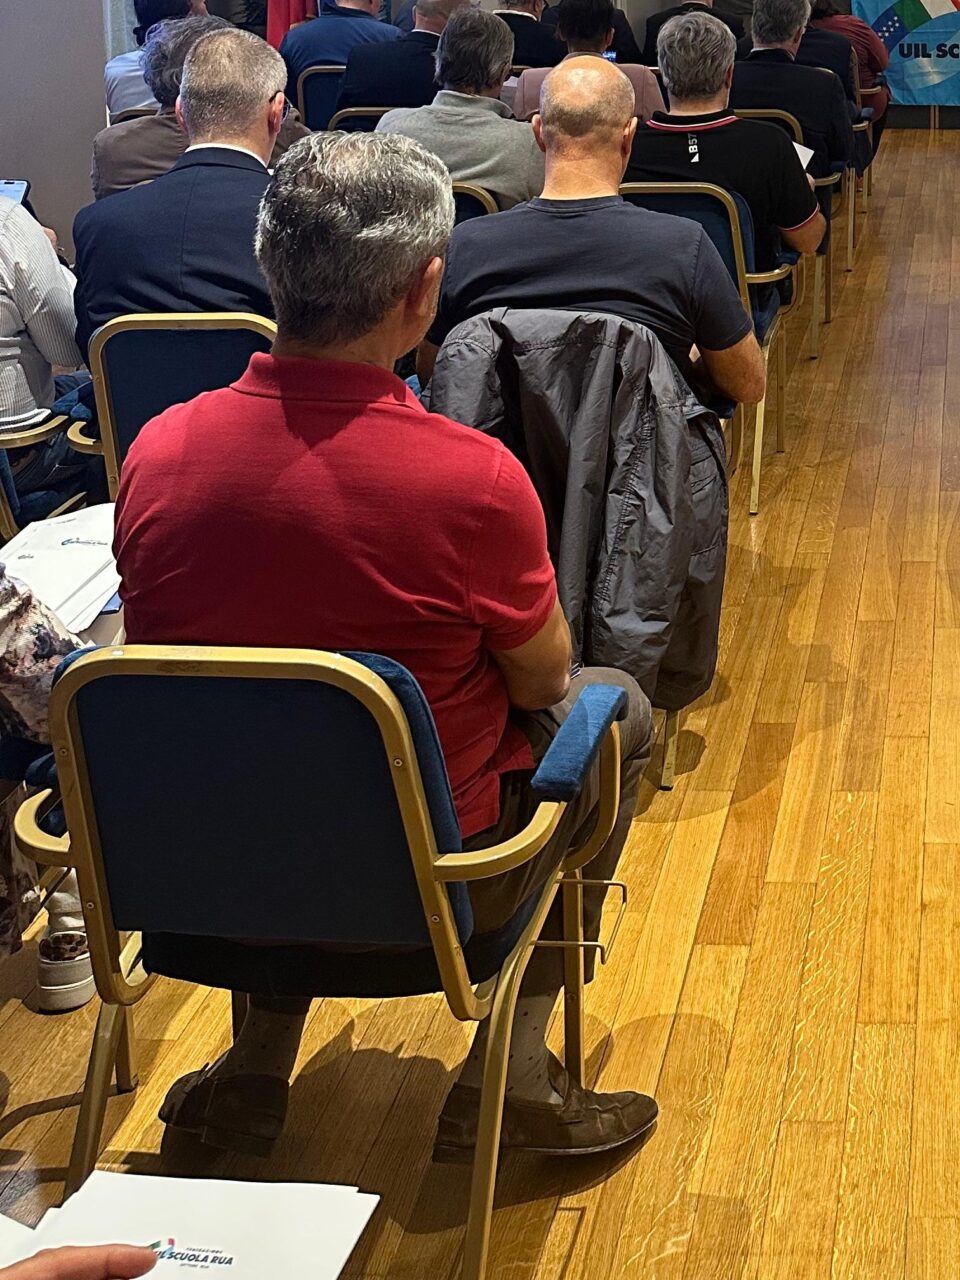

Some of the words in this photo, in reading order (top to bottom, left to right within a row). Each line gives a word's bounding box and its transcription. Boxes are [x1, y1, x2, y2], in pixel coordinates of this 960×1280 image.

[899, 42, 932, 59] UIL
[168, 1251, 209, 1263] SCUOLA
[210, 1254, 234, 1265] RUA
